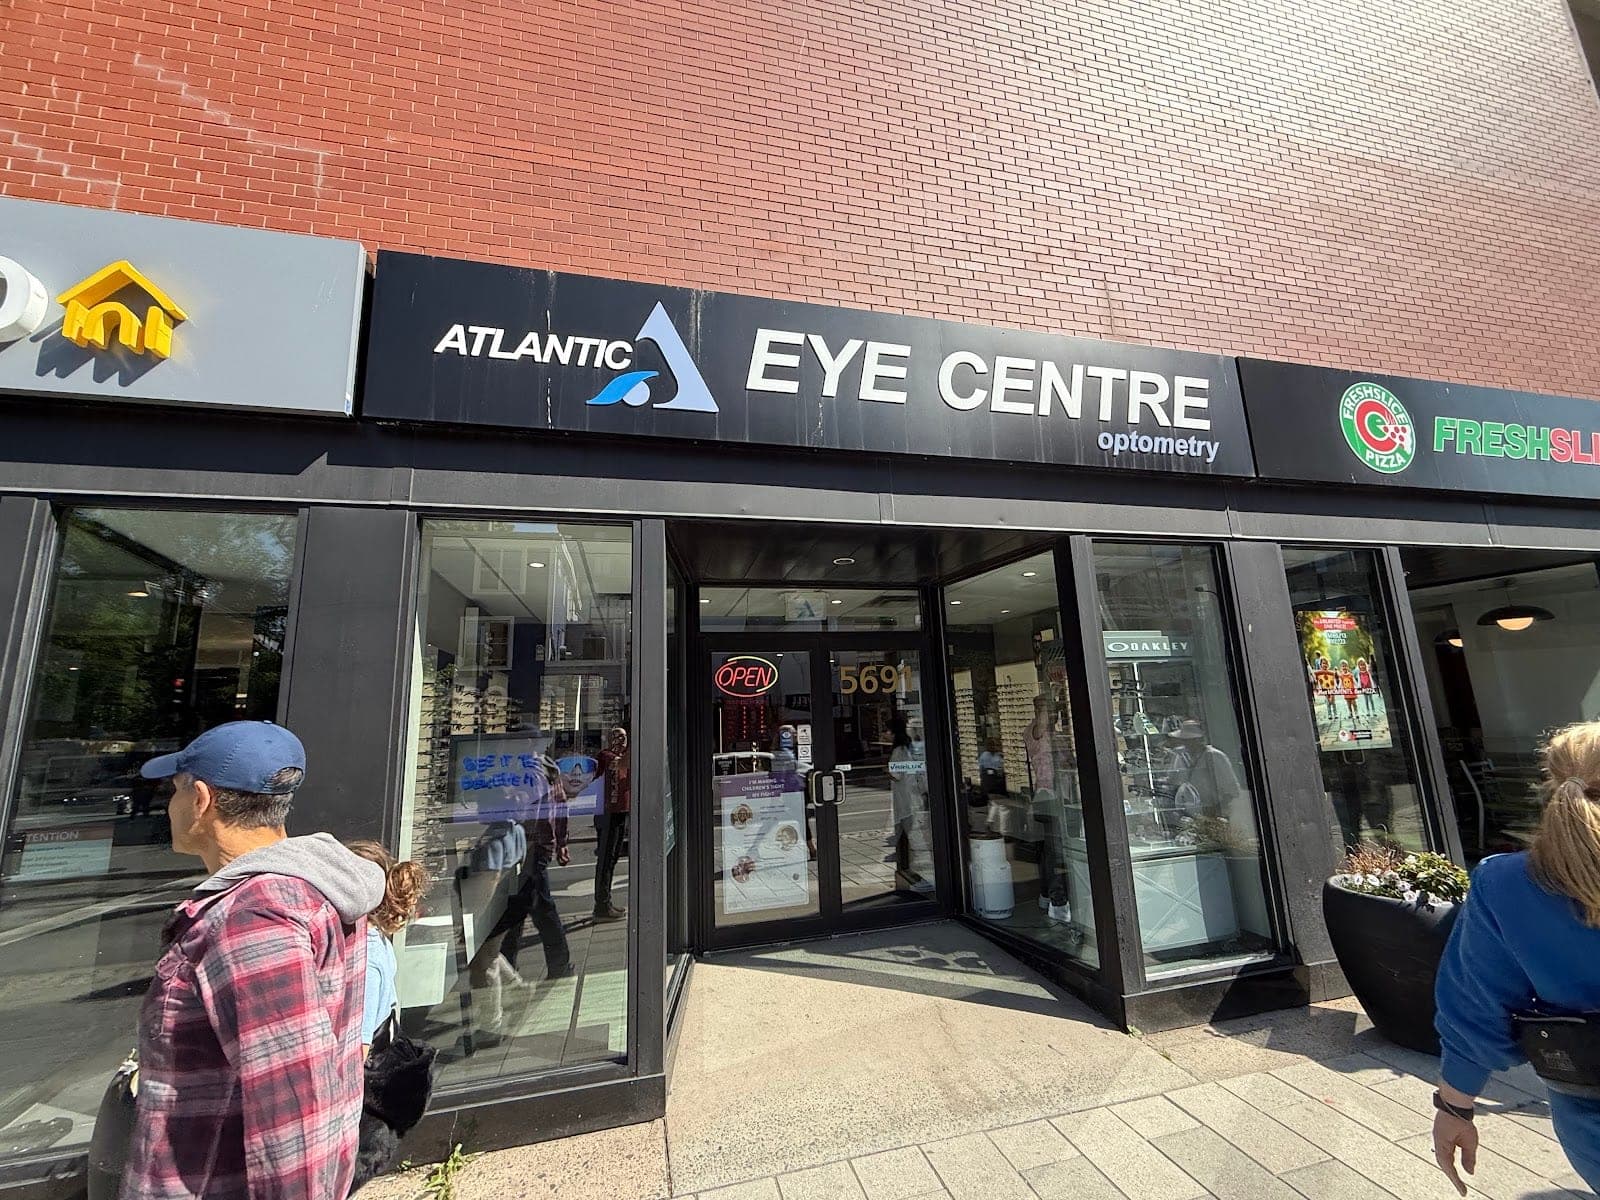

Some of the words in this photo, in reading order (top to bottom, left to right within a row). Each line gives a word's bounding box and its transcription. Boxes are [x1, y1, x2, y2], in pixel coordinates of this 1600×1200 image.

[433, 324, 633, 370] ATLANTIC
[746, 329, 911, 405] EYE
[938, 351, 1213, 431] CENTRE
[1344, 386, 1407, 424] FRESHSLICE
[1098, 430, 1220, 463] optometry
[1365, 450, 1405, 467] PIZZA
[1131, 642, 1188, 651] OAKLEY
[719, 667, 772, 687] OPEN
[841, 666, 912, 695] 5691
[26, 830, 79, 842] TENTION
